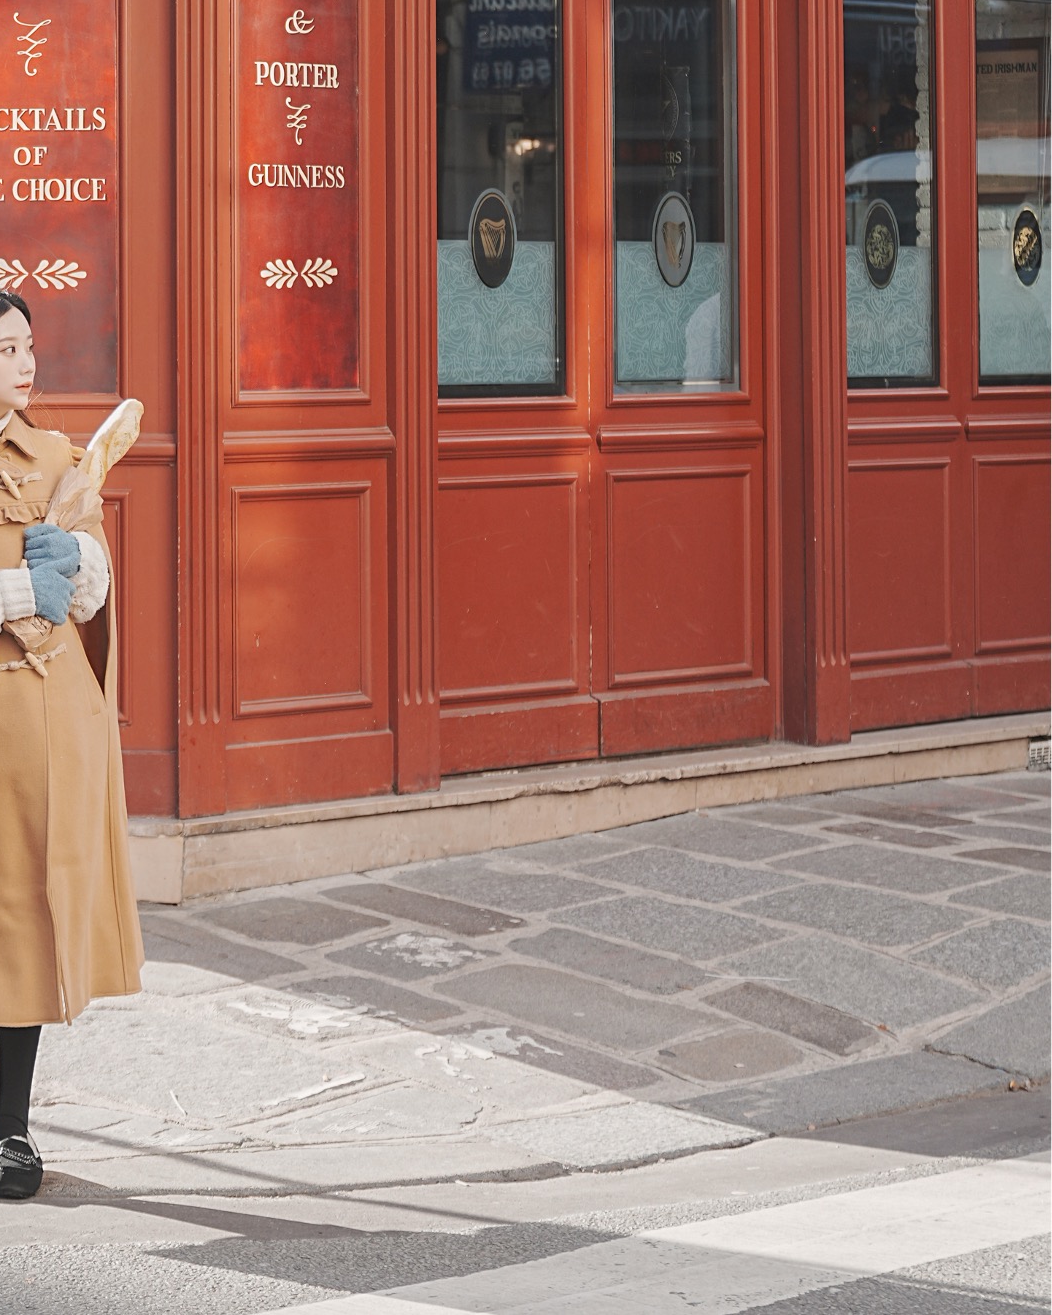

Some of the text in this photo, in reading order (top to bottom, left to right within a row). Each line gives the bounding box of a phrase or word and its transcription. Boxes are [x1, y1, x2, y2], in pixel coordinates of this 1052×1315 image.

[285, 9, 315, 35] &
[254, 61, 339, 89] PORTER
[994, 62, 1037, 74] IRISHMAN
[13, 146, 48, 166] OF
[248, 163, 345, 189] GUINNESS
[12, 177, 107, 202] CHOICE
